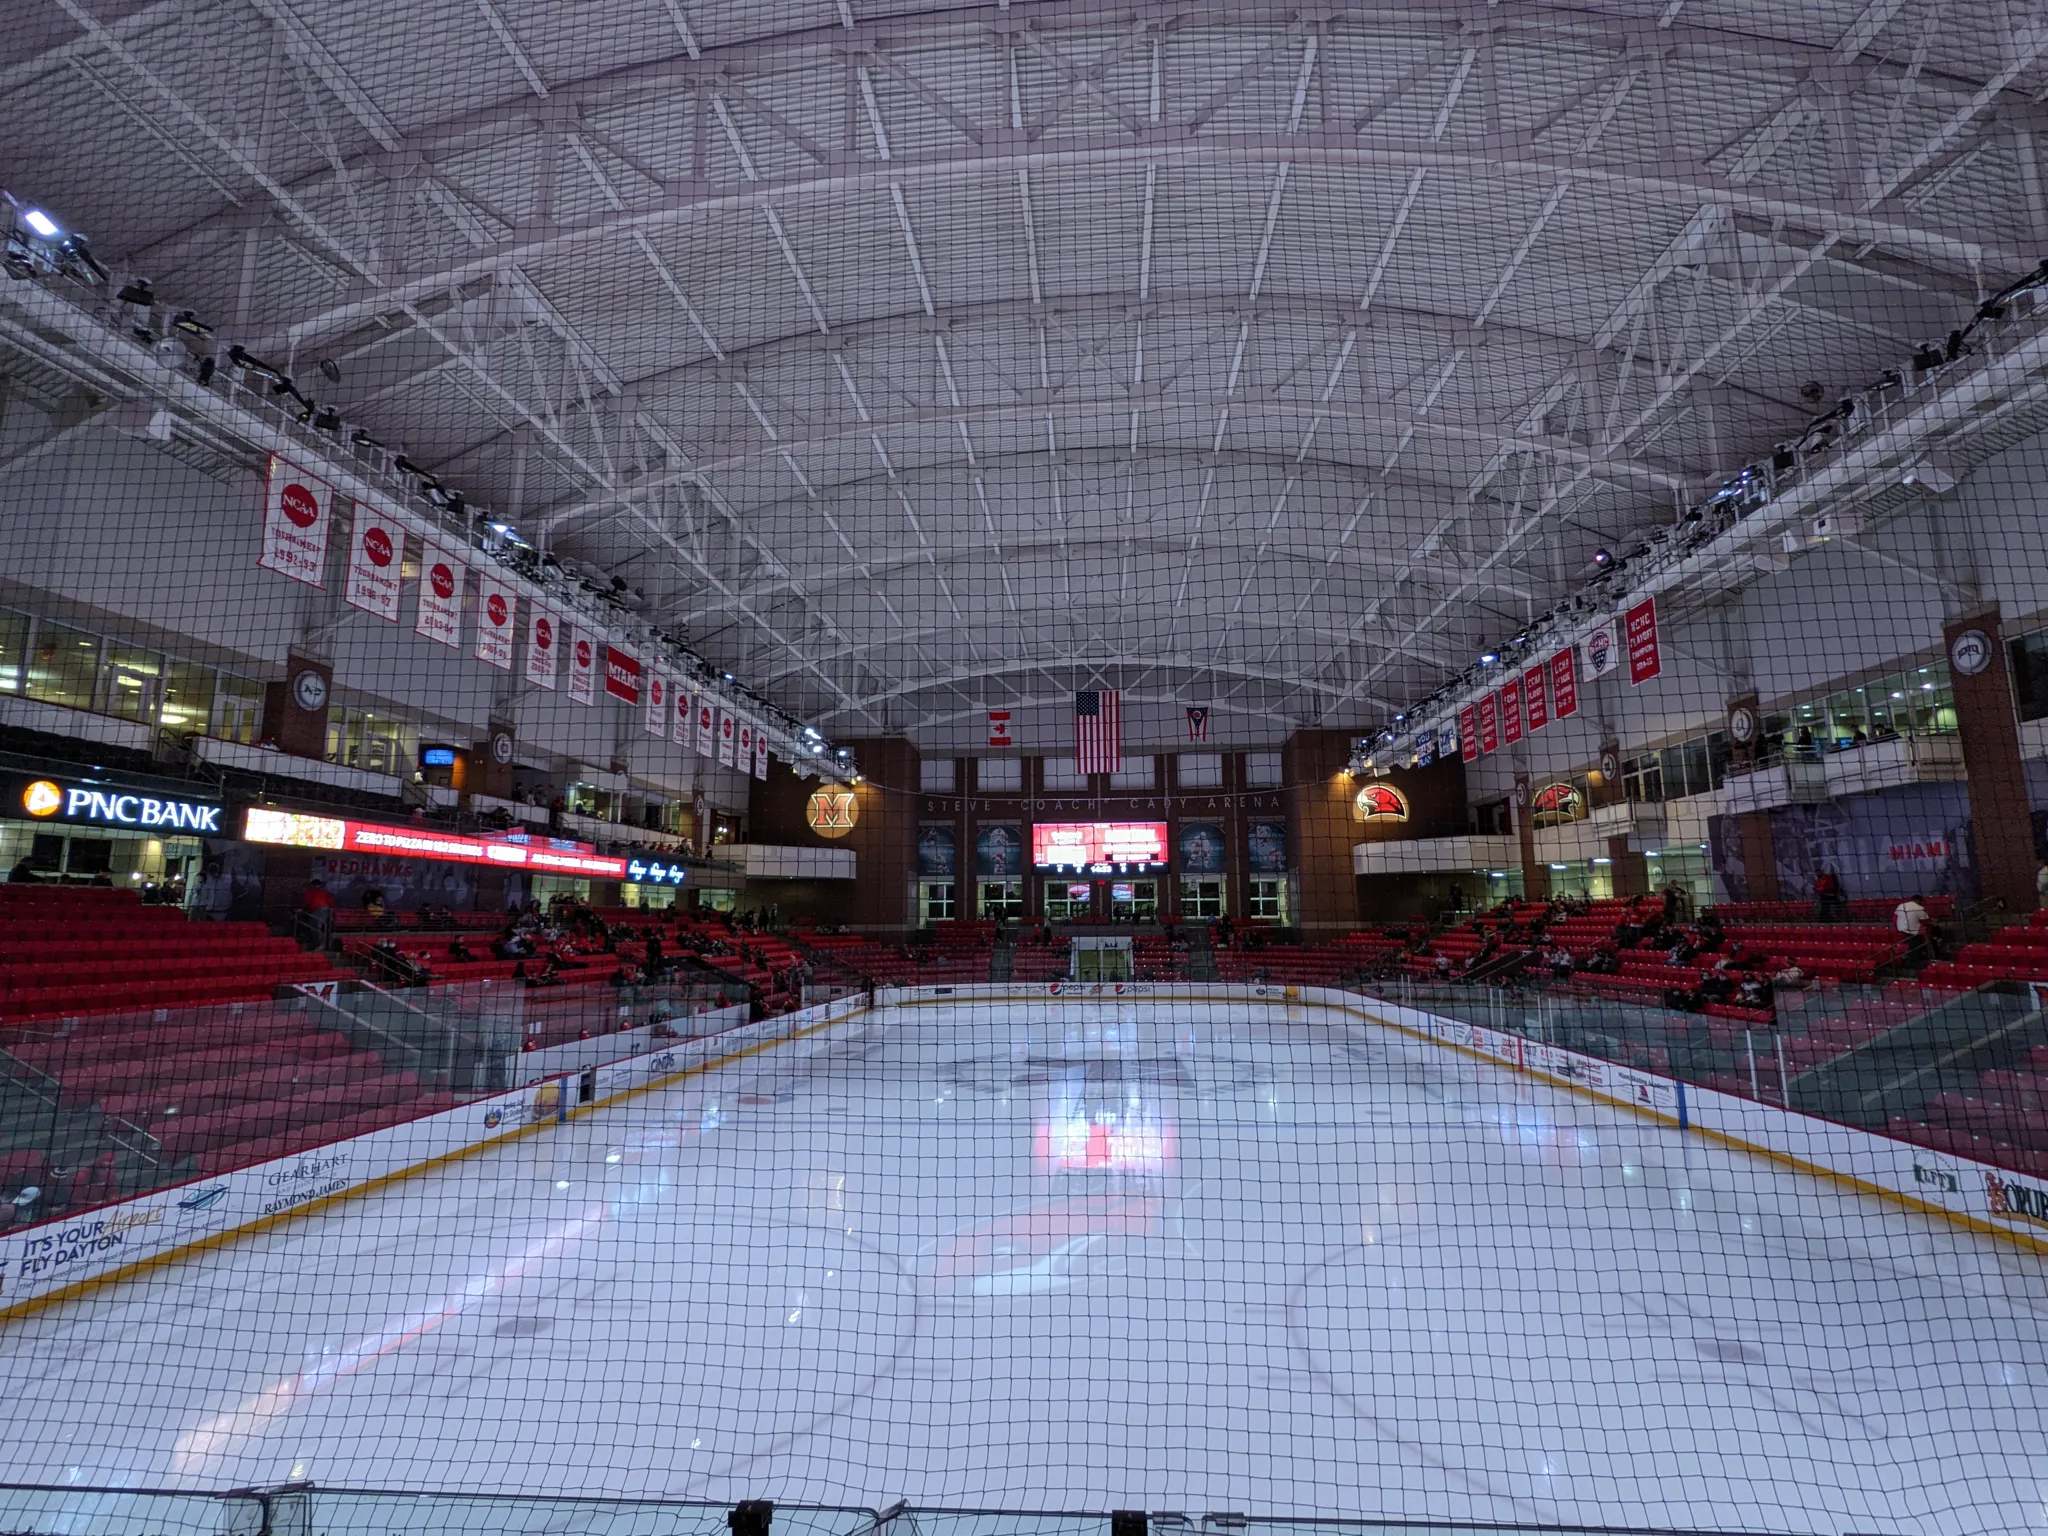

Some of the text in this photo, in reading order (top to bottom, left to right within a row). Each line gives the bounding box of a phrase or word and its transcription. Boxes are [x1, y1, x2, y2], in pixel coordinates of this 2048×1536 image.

[282, 494, 316, 518] NCAA
[364, 536, 391, 557] NCAA
[431, 572, 454, 591] NCAA
[488, 601, 507, 618] NCAA
[607, 661, 640, 691] MIAMI
[1417, 732, 1430, 745] YOU
[811, 793, 854, 827] M
[927, 801, 991, 812] STEVE
[1130, 798, 1188, 809] CADY
[1208, 796, 1279, 808] ARENA
[1889, 840, 1950, 861] MIAMI
[328, 859, 413, 878] REDHAWKS
[1063, 983, 1086, 992] pepsi
[268, 1153, 348, 1187] GEARHART
[264, 1180, 346, 1215] RAYMOND JAMES
[57, 1221, 104, 1247] YOUR
[102, 1203, 164, 1232] Airport
[20, 1231, 124, 1277] FLY DAYTON
